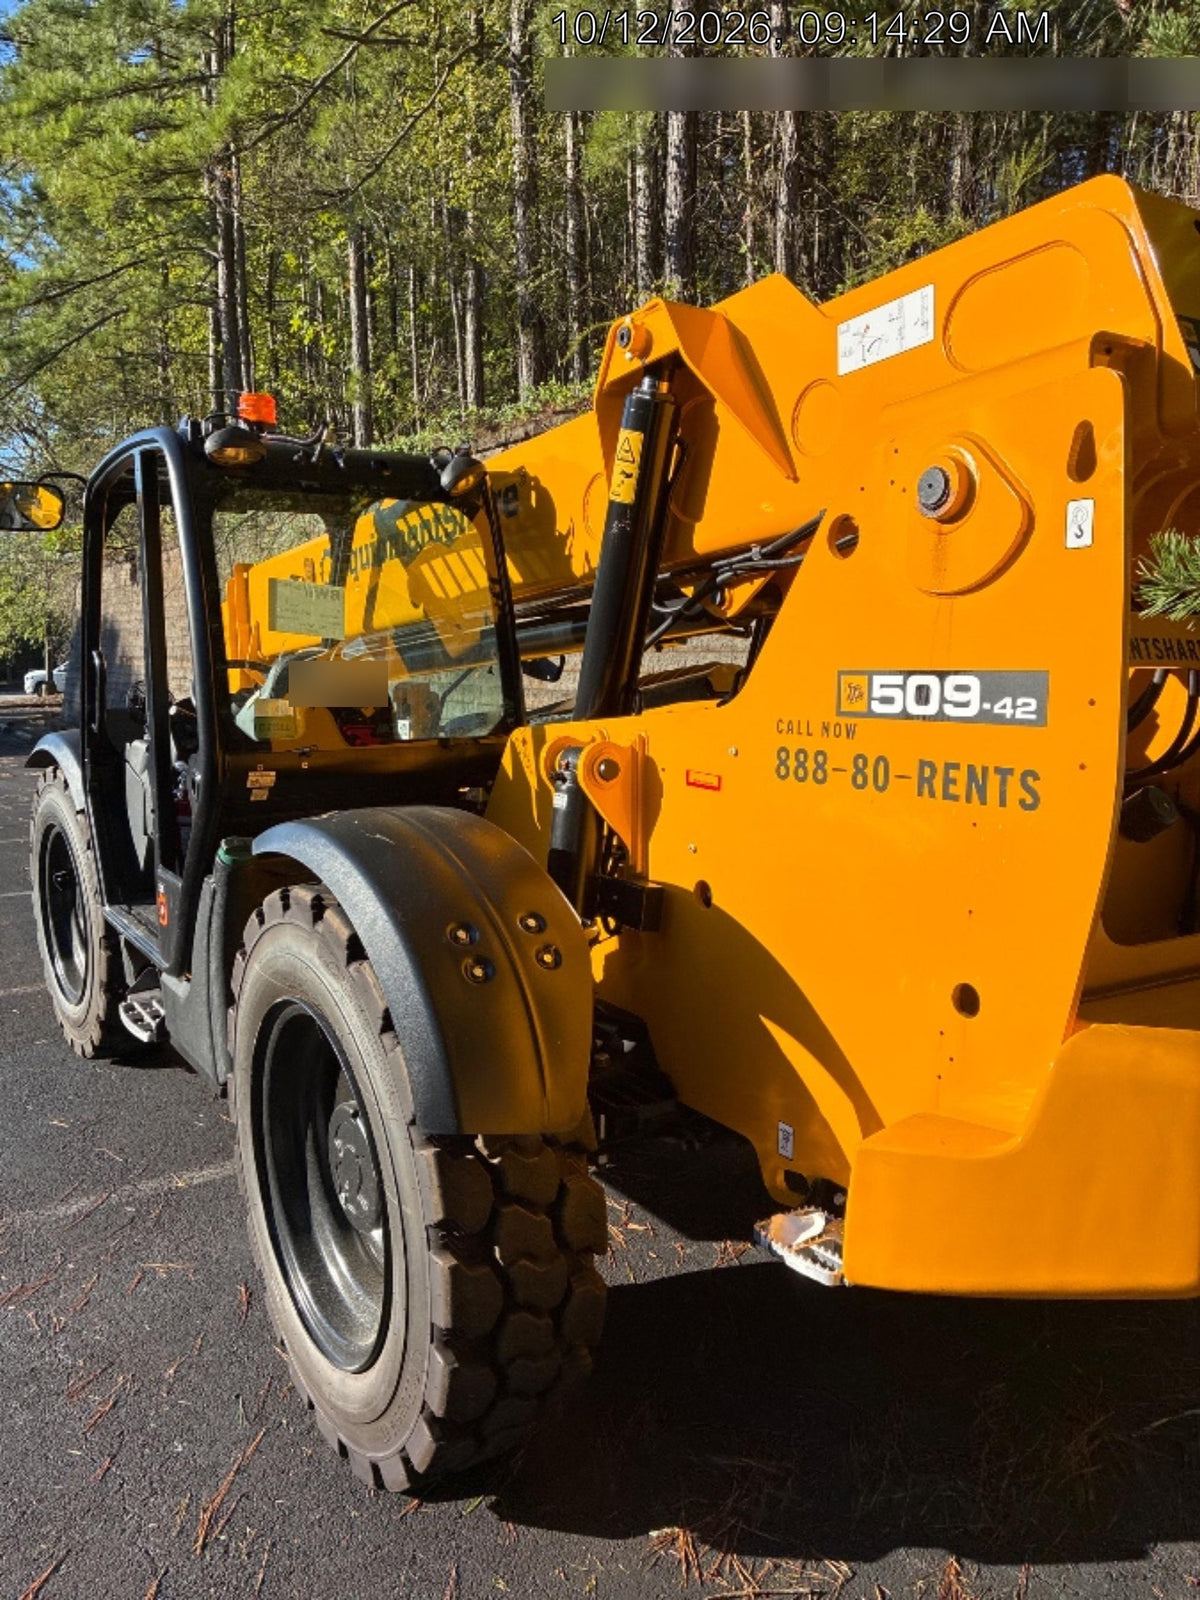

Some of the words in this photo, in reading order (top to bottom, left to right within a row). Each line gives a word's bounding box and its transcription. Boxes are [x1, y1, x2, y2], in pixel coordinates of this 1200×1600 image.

[1130, 637, 1200, 660] NTSHAR
[870, 674, 1038, 719] 509-42
[776, 719, 813, 737] CALL
[821, 721, 858, 740] NOW
[775, 746, 1041, 812] 888-80-RENTS
